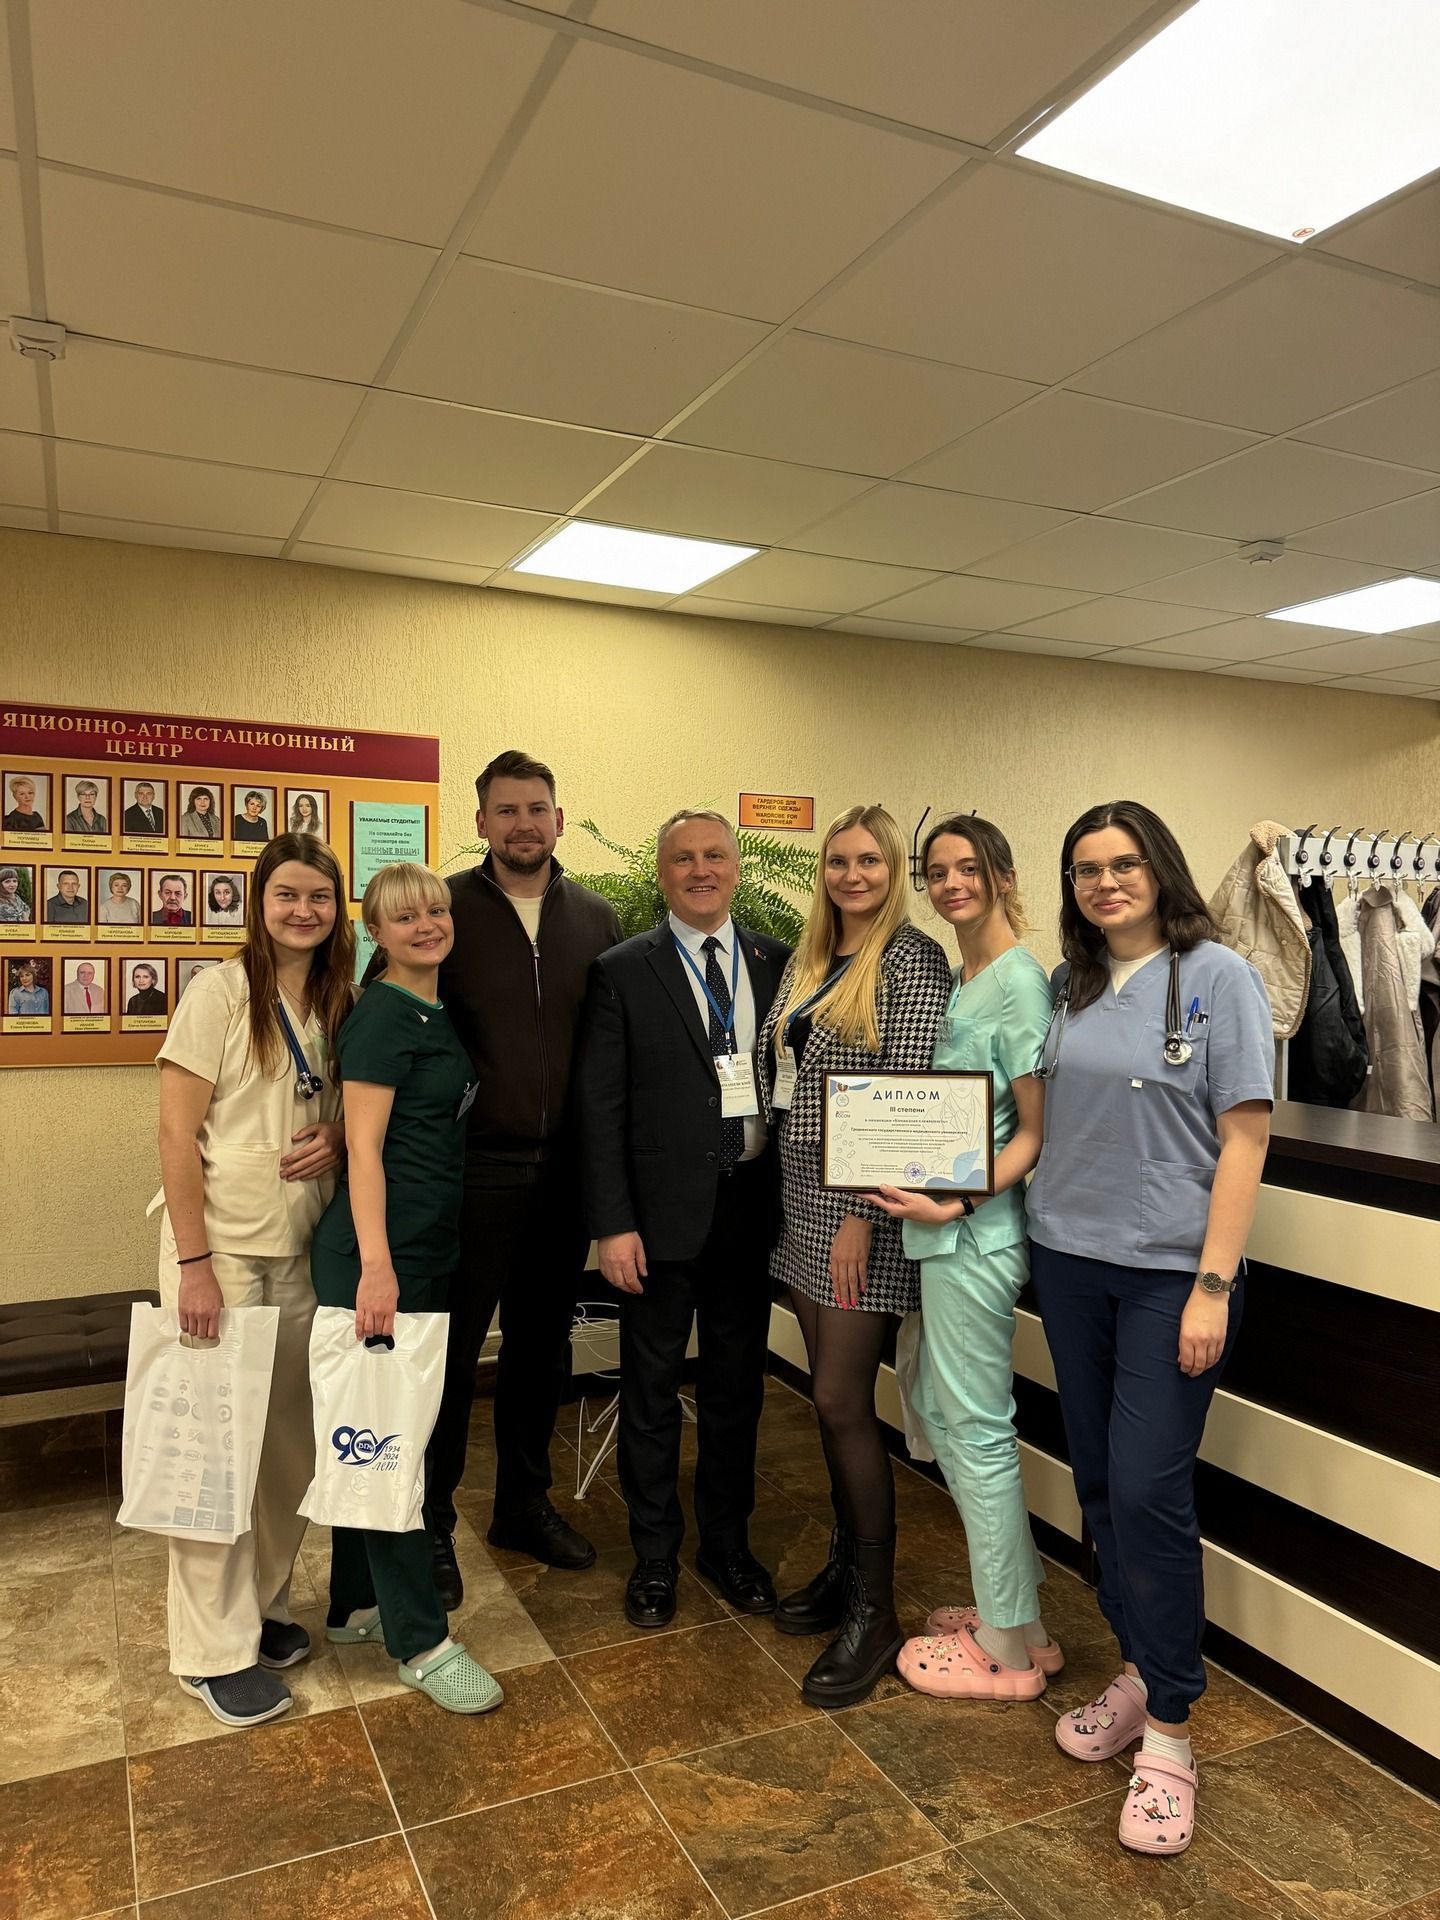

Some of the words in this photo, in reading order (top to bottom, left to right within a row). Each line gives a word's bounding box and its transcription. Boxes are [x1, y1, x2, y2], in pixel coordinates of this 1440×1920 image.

[2, 712, 356, 753] ЯЦИОННО-АТТЕСТАЦИОННЫЙ
[105, 739, 184, 758] ЦЕНТР
[360, 846, 394, 855] ЦЕННЫЕ
[394, 847, 420, 856] ВЕЩИ!
[872, 1090, 940, 1101] ДИПЛОМ
[384, 1445, 401, 1453] 1934
[382, 1452, 399, 1461] 2024
